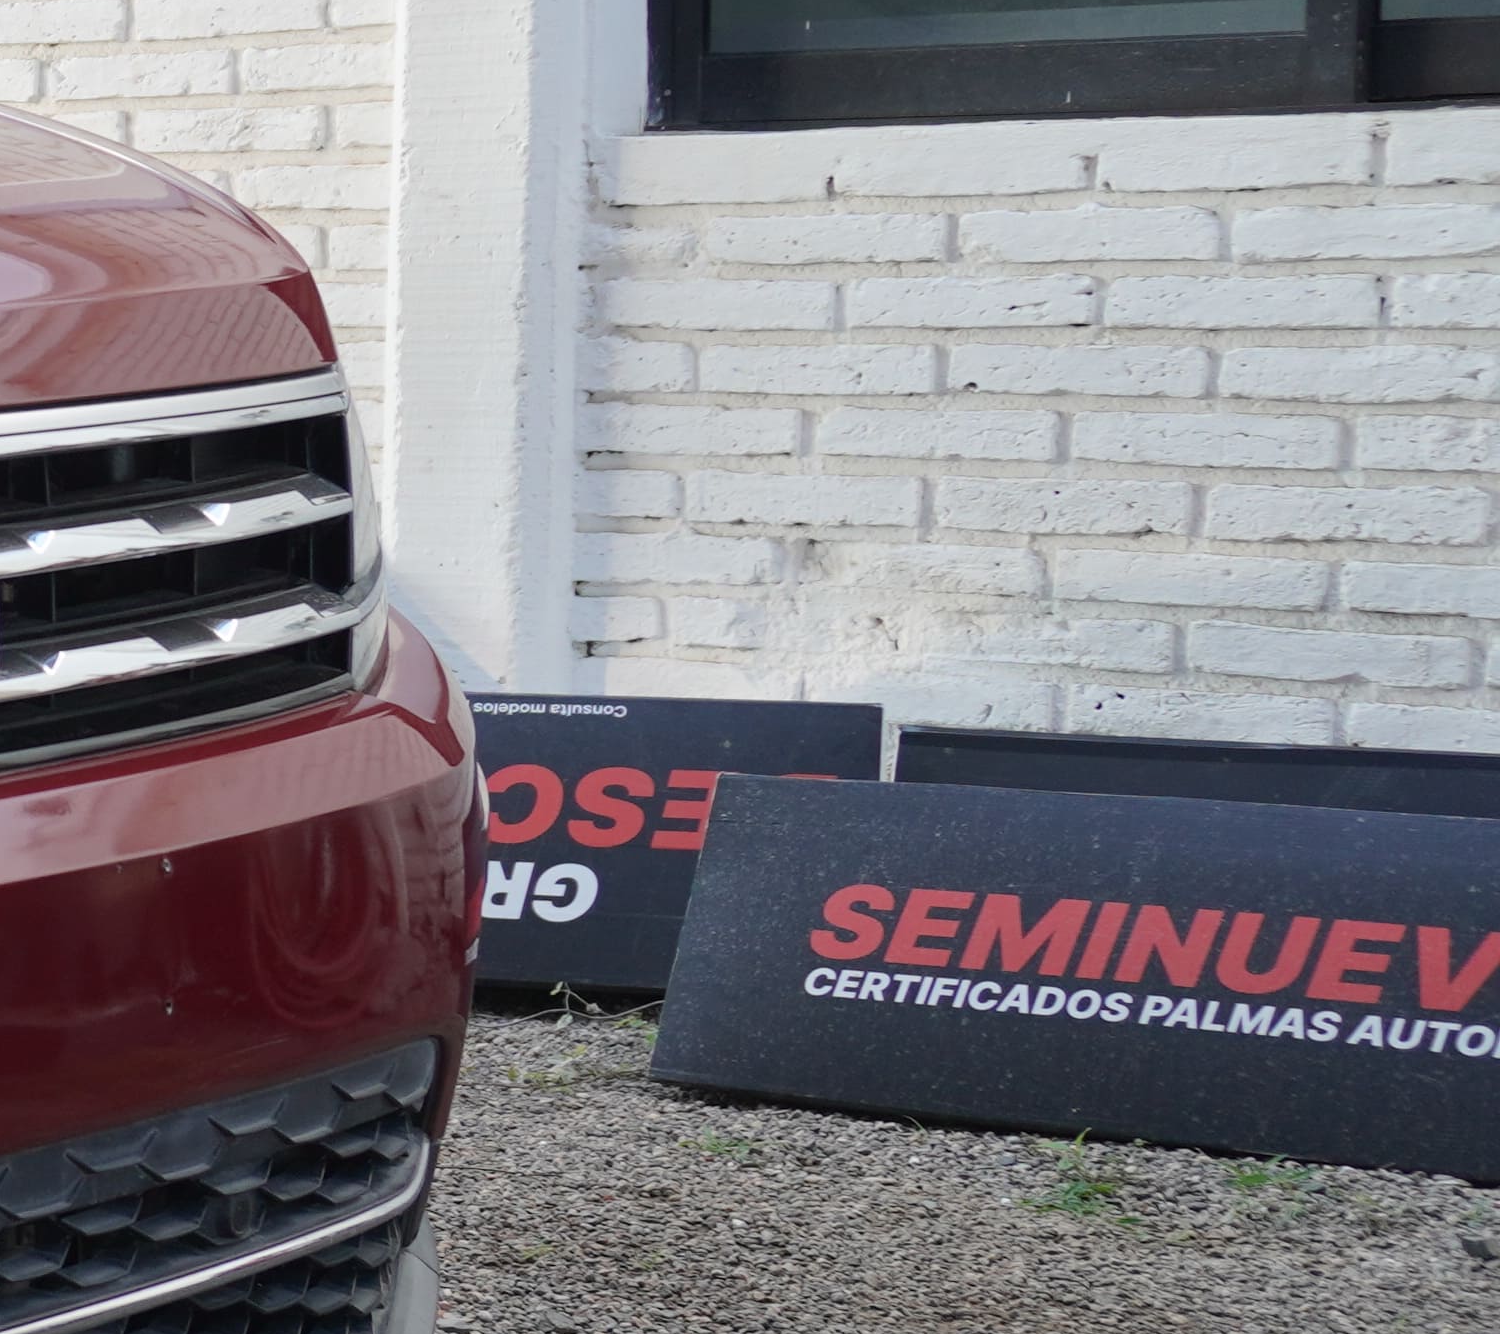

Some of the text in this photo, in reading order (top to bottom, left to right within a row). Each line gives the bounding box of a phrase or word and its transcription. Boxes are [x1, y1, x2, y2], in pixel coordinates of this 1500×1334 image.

[473, 702, 628, 718] Consulta modelos
[810, 883, 1500, 1012] SEMINUEV
[804, 967, 1500, 1060] CERTIFICADOS PALMAS AUTO
